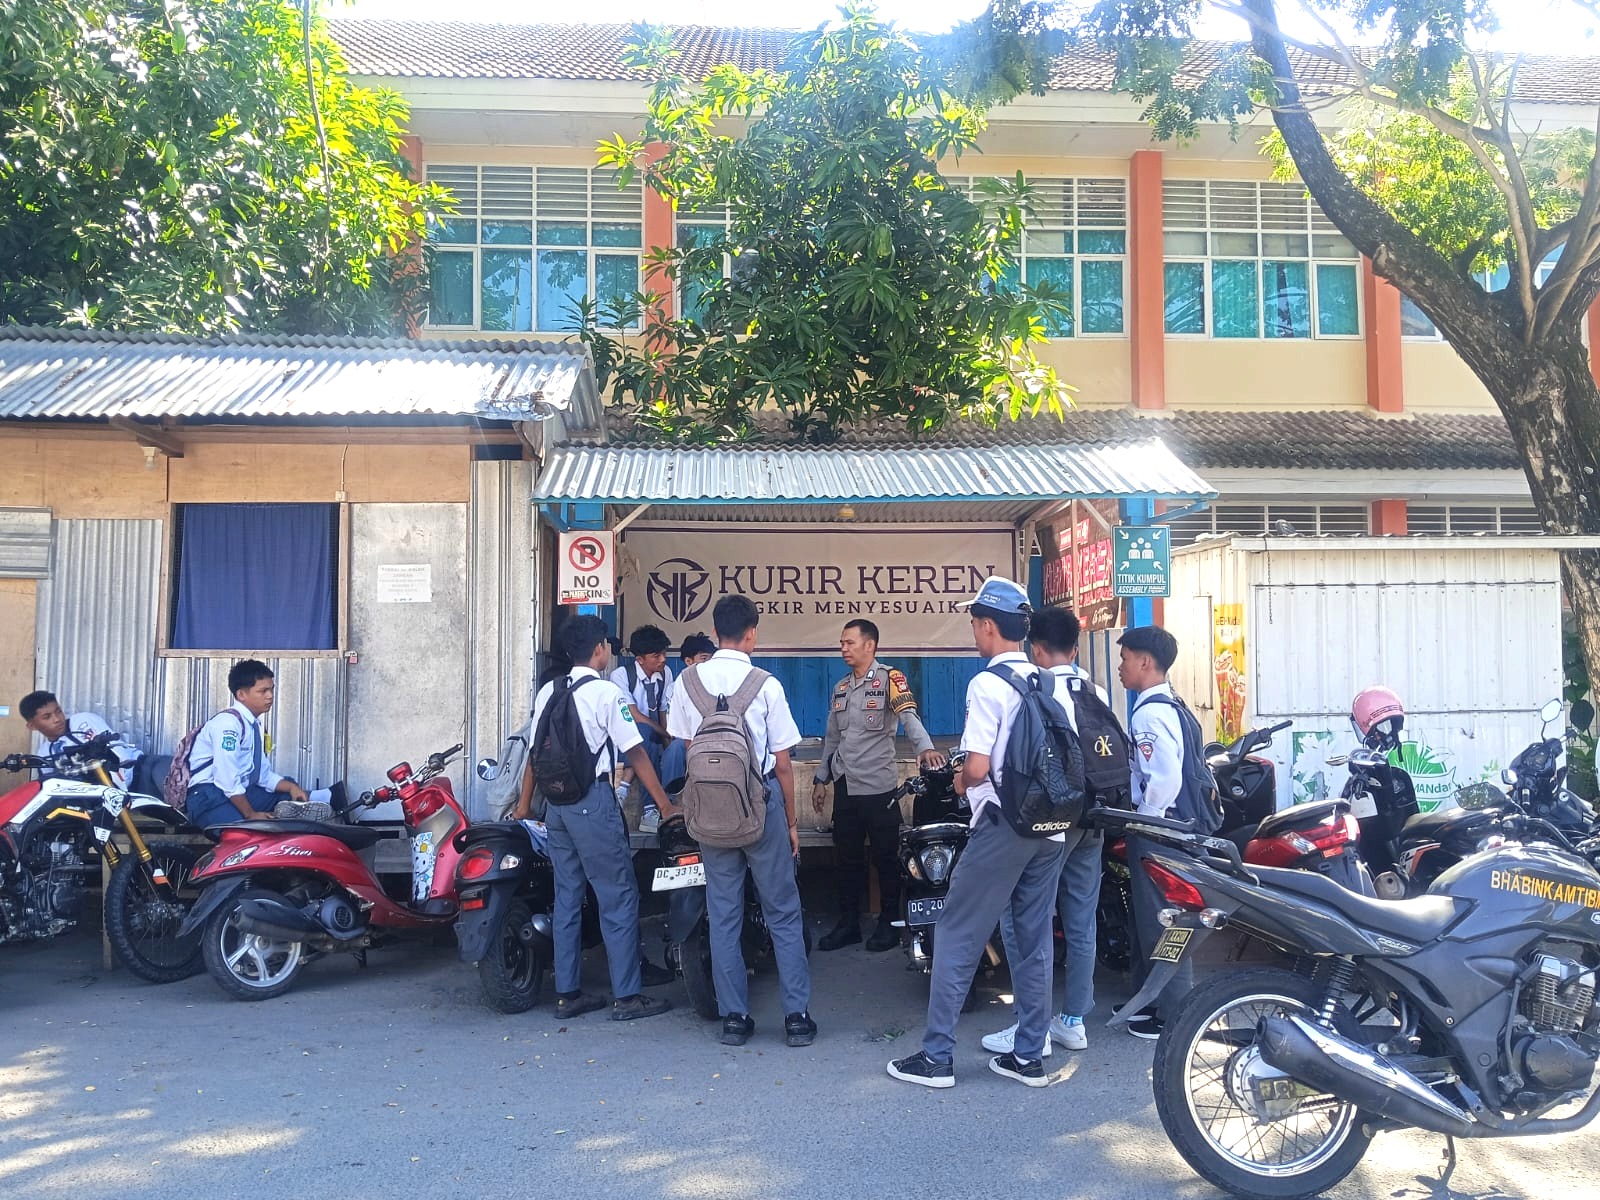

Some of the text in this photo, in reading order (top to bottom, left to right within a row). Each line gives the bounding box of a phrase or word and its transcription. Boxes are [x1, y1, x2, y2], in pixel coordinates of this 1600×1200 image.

[573, 575, 600, 588] NO
[718, 564, 996, 595] KURIR KEREN
[1117, 573, 1167, 584] TITIK KUMPUL
[1117, 585, 1148, 594] ASSEMBLY
[754, 601, 804, 614] GKIR
[1032, 821, 1072, 832] adidas
[656, 865, 699, 879] DC 3319
[911, 900, 946, 913] DC 20
